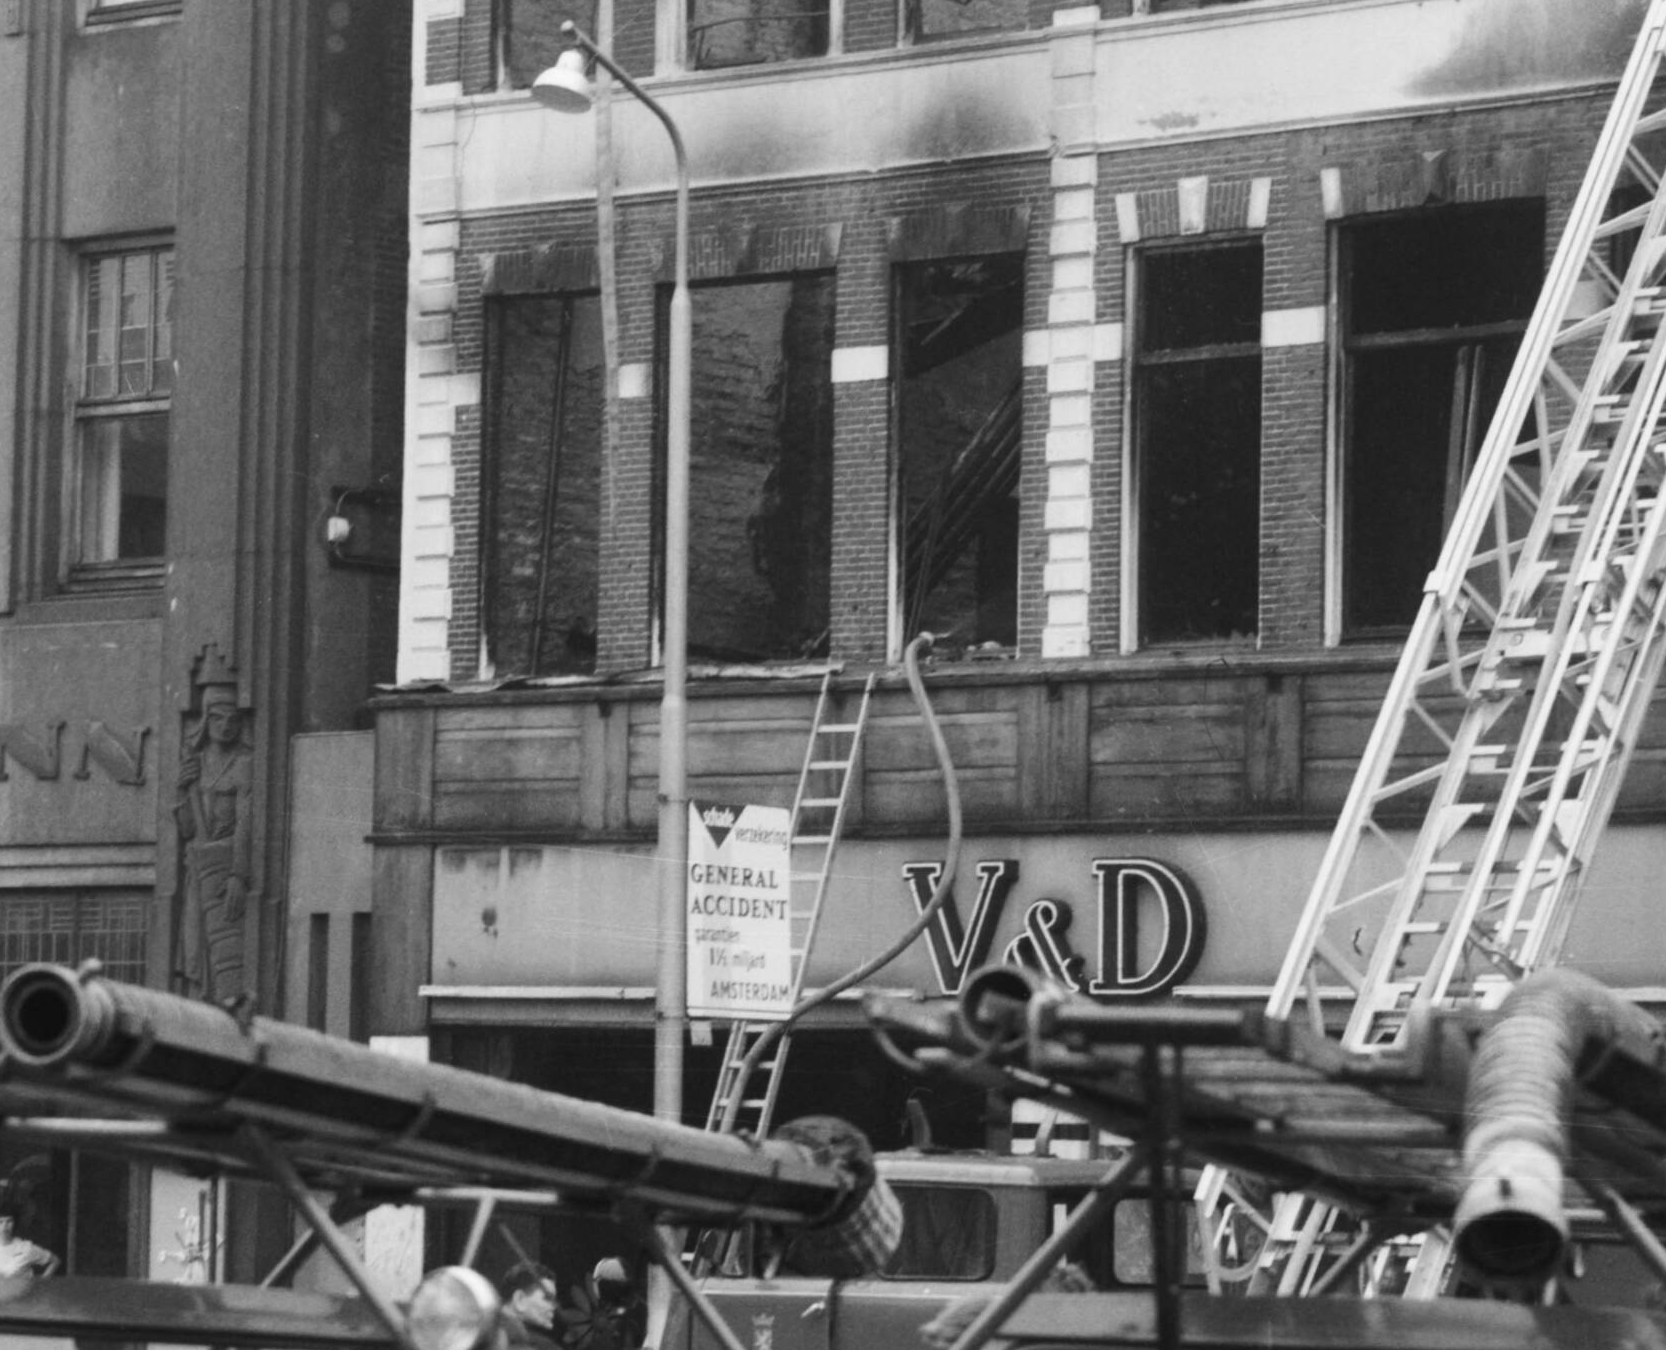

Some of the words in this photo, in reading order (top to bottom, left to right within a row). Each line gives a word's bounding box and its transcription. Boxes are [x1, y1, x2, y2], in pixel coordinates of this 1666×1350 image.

[690, 862, 780, 890] GENERAL
[691, 894, 789, 921] ACCIDENT
[902, 857, 1209, 997] V&D
[710, 979, 790, 1002] AMSTERDAM
